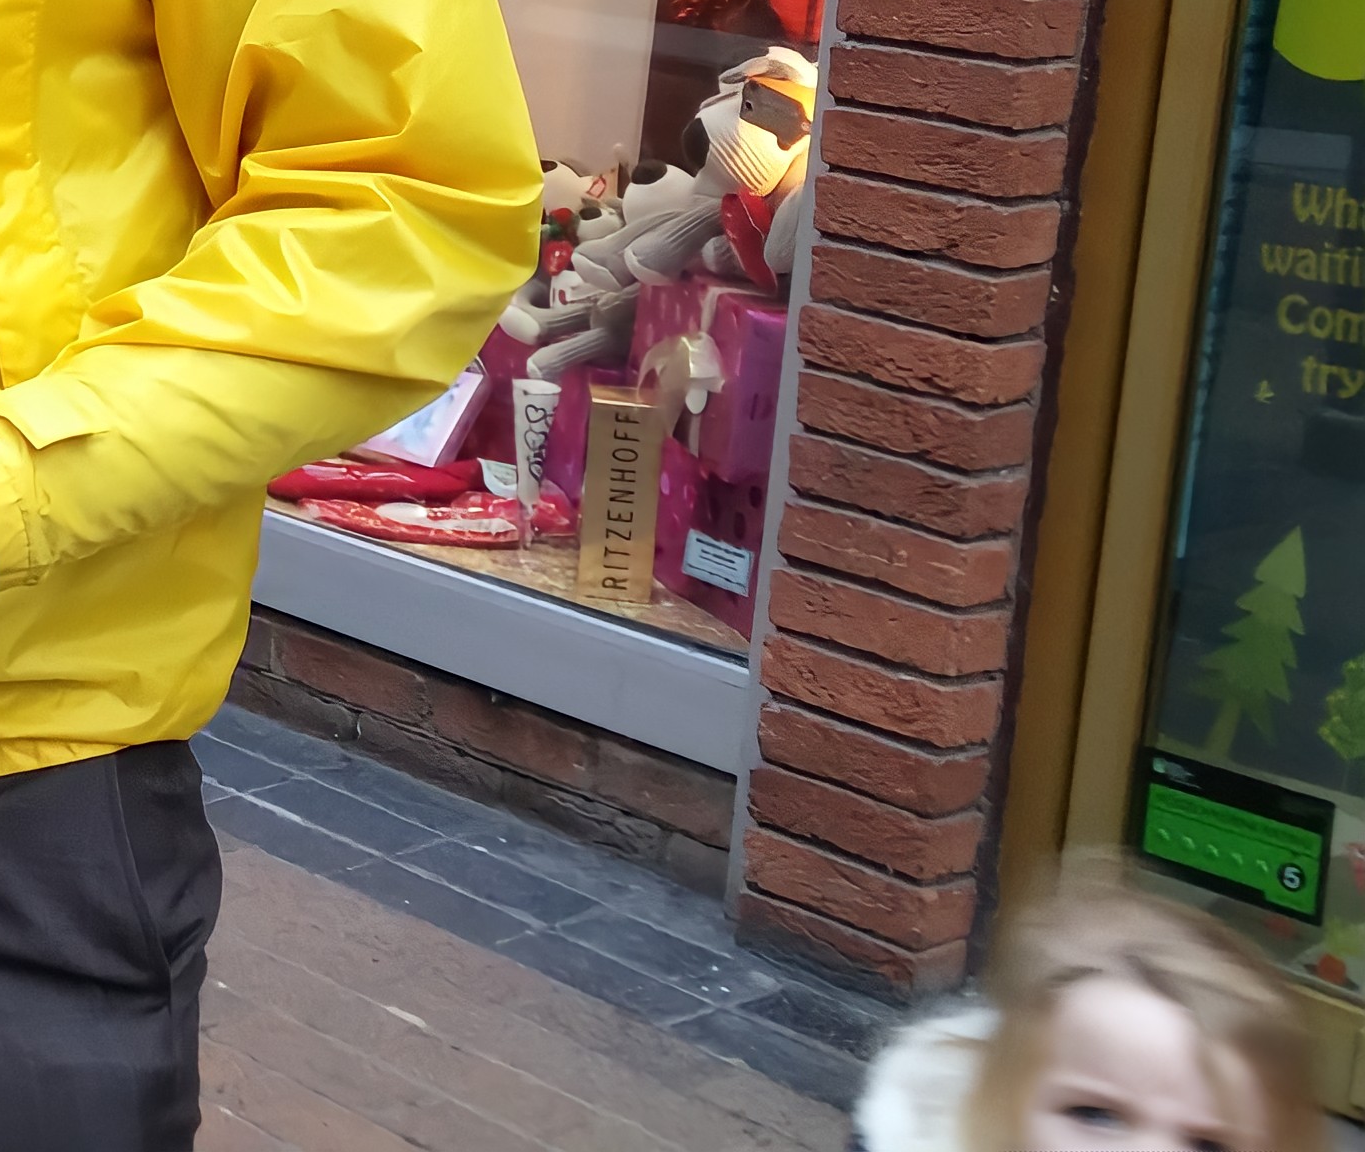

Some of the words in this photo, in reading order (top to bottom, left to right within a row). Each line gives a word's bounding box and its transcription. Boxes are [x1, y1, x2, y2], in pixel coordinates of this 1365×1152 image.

[1292, 181, 1365, 230] Wh
[601, 411, 641, 591] RITZENHOFF
[1282, 865, 1301, 890] 5
